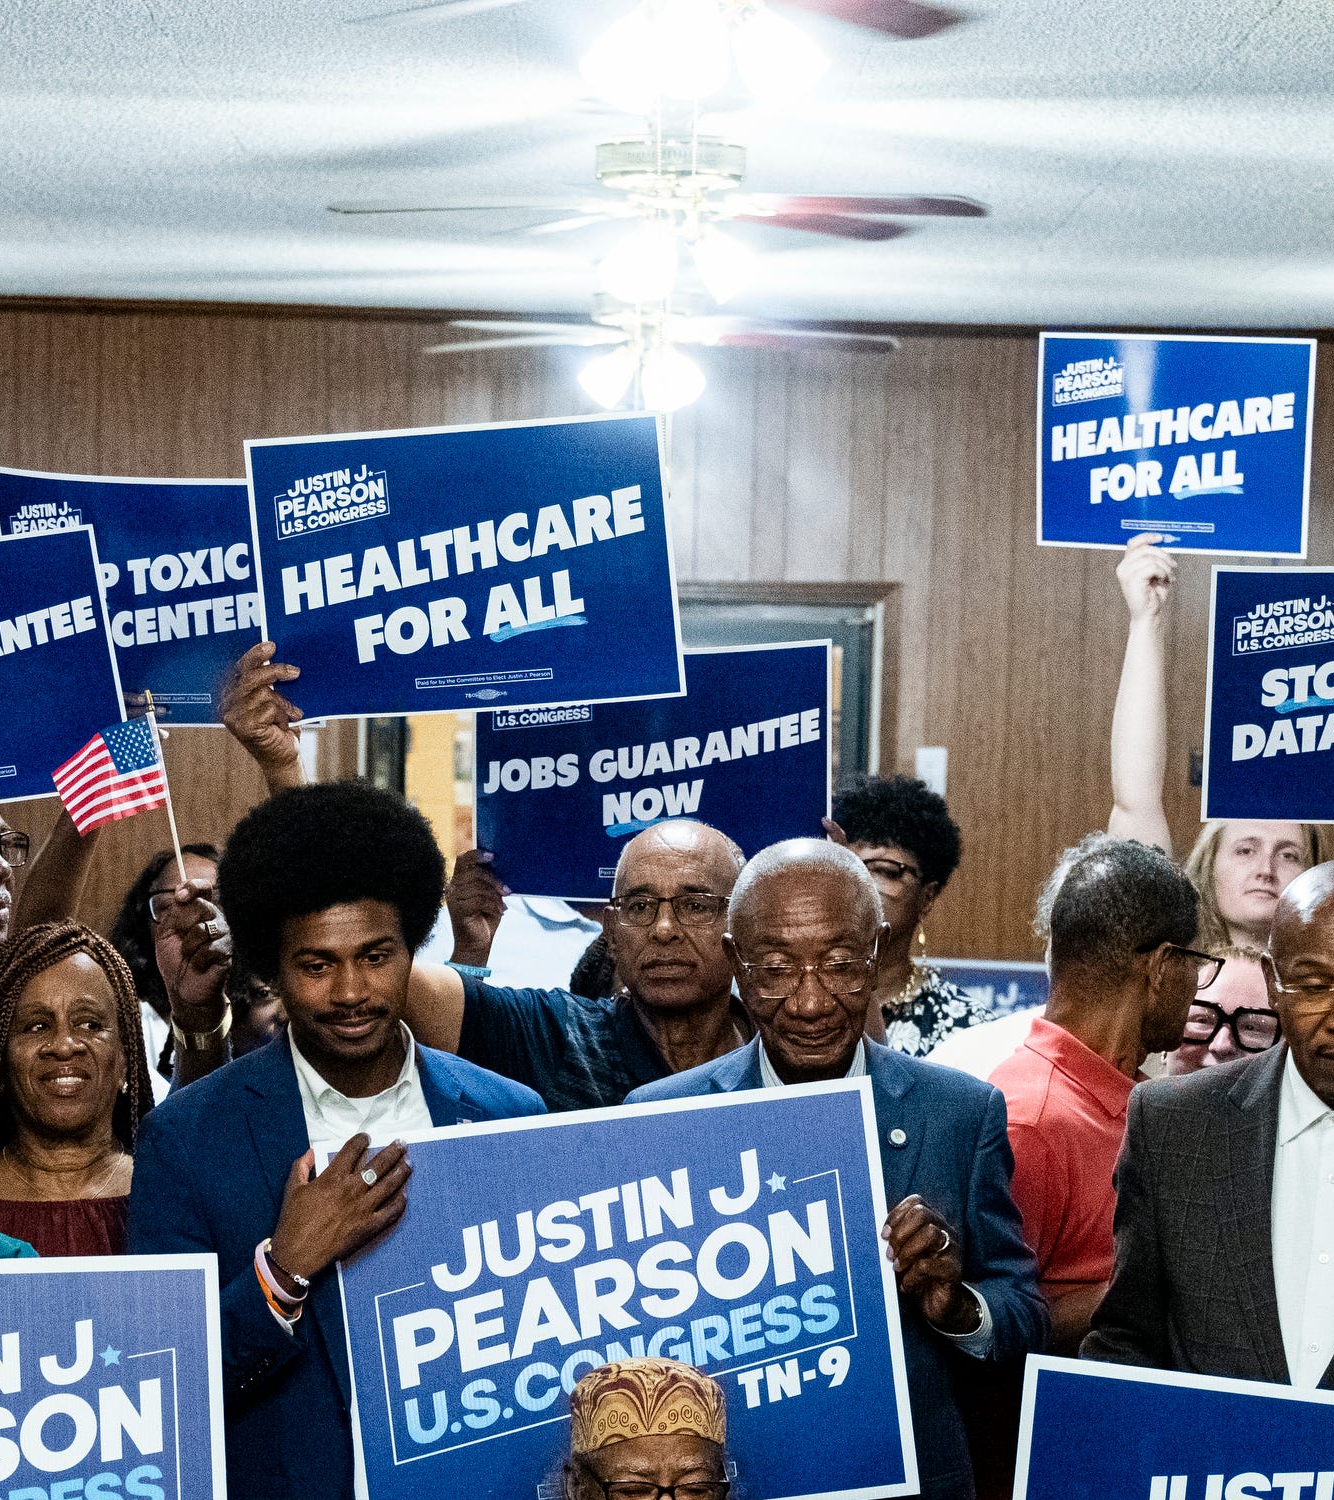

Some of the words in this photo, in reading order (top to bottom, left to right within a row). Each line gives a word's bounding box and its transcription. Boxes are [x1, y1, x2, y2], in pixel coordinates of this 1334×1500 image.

[1055, 368, 1122, 392] PEARSON
[1063, 360, 1103, 376] JUSTIN
[1051, 392, 1295, 461] HEALTHCARE
[278, 478, 385, 521] PEARSON
[287, 468, 351, 497] JUSTIN
[1090, 461, 1163, 504] FOR
[1169, 450, 1244, 493] ALL
[17, 503, 57, 519] JUSTIN
[127, 543, 250, 595] TOXIC
[282, 485, 646, 615] HEALTHCARE
[111, 592, 262, 647] CENTER
[354, 597, 471, 663] FOR
[483, 570, 585, 635] ALL
[1247, 599, 1310, 620] JUSTIN
[520, 707, 590, 726] CONGRESS
[484, 754, 579, 794] JOBS
[588, 708, 820, 783] GUARANTEE
[602, 779, 704, 826] NOW
[430, 1168, 693, 1293] JUSTIN
[392, 1200, 834, 1390] PEARSON
[738, 1346, 851, 1409] TN-9
